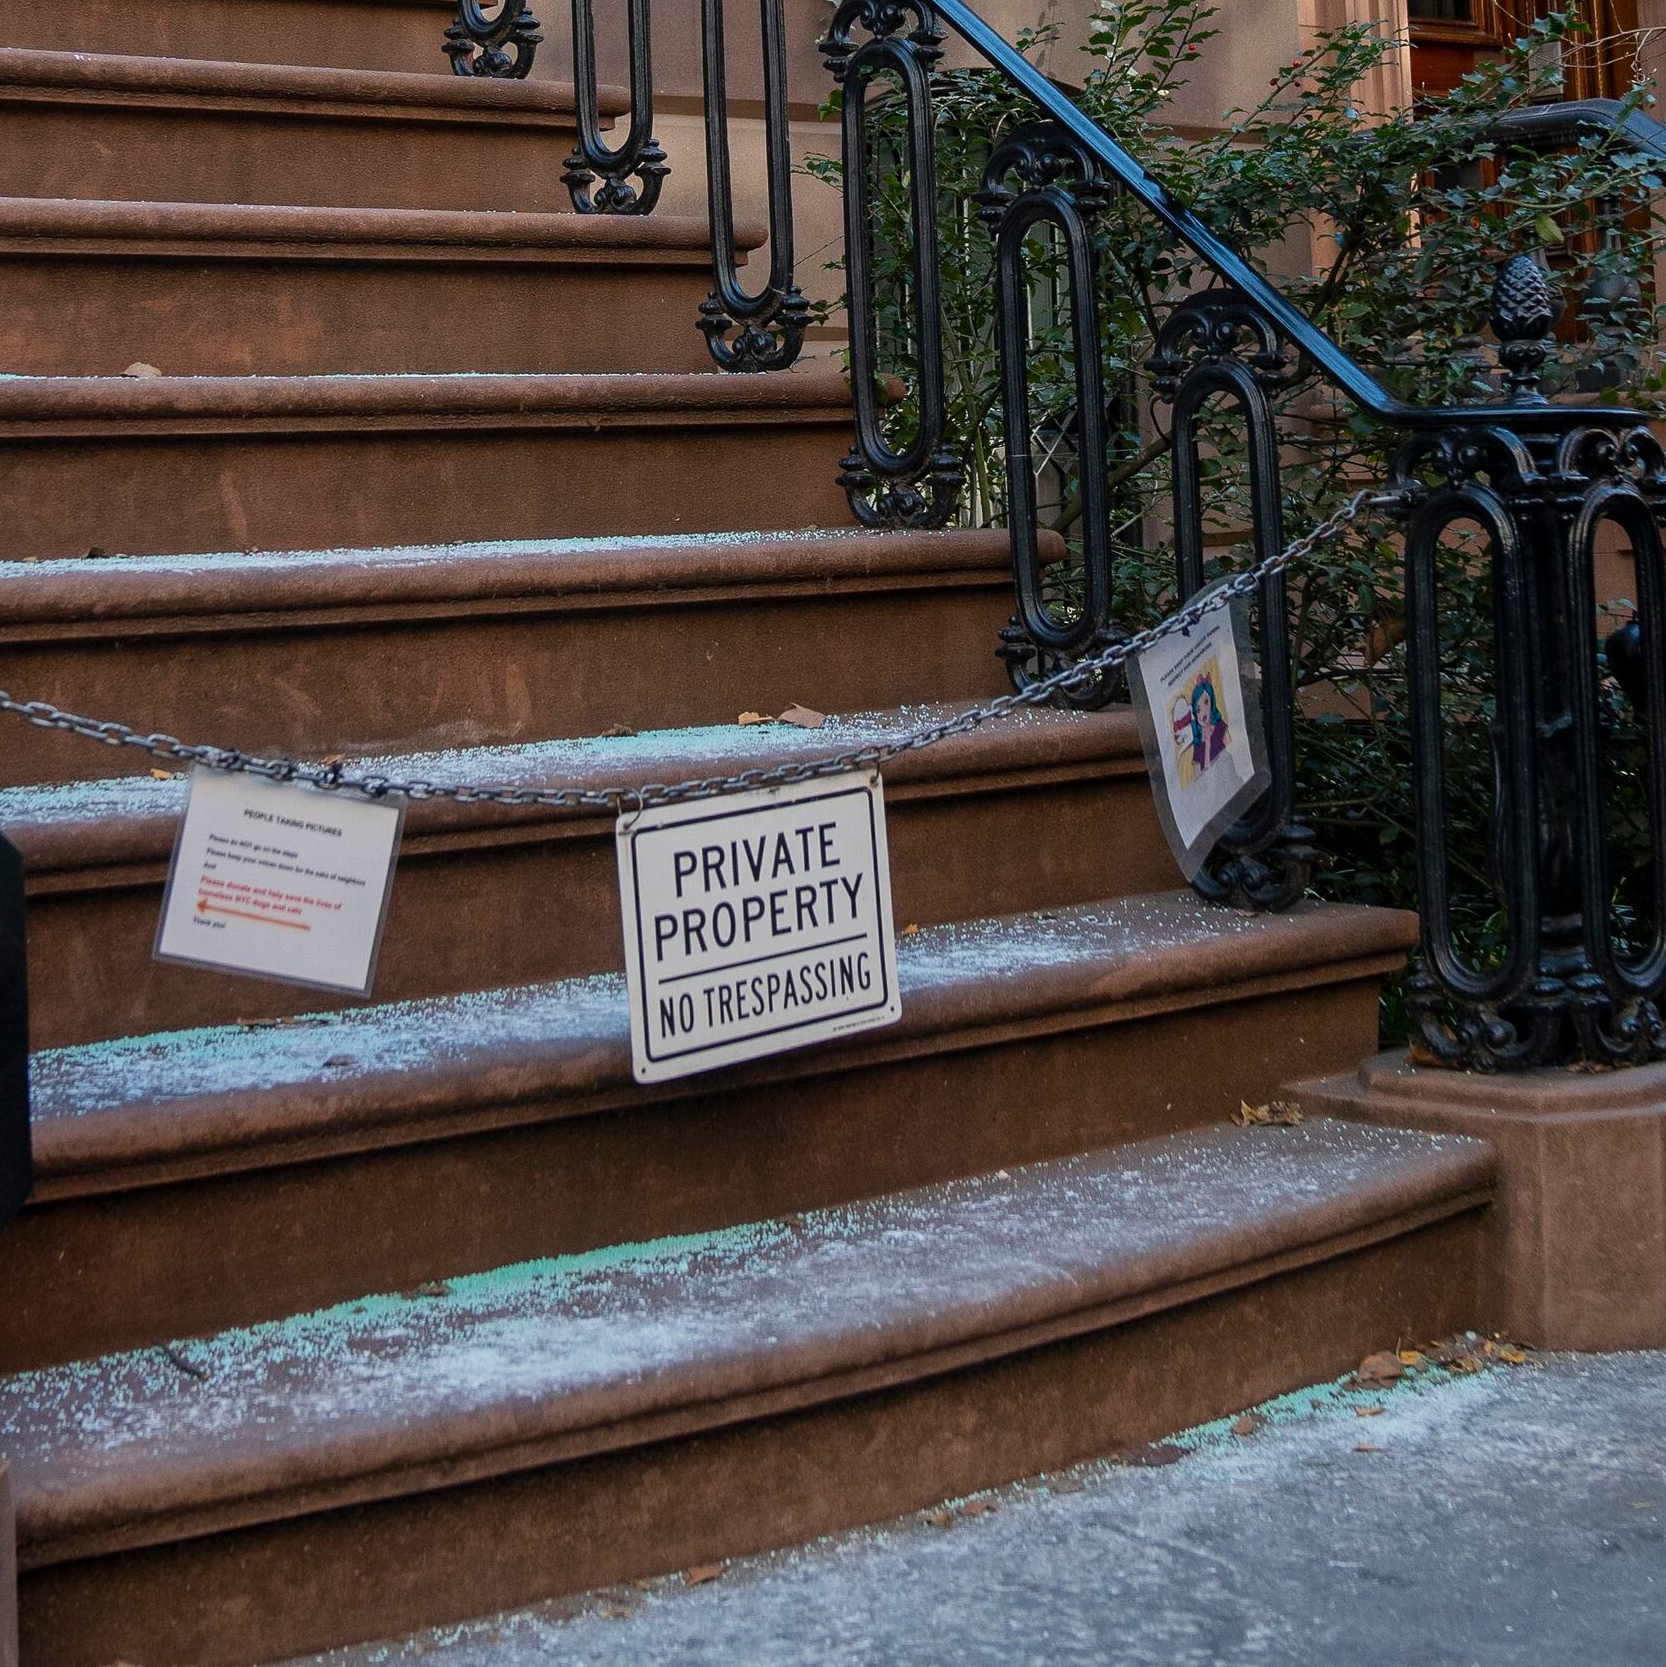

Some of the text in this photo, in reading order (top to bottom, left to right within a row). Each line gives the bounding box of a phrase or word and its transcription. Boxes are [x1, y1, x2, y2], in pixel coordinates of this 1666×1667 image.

[244, 809, 342, 836] PEOPLE TAKING PICTURES
[206, 847, 227, 857] Please
[209, 833, 229, 844] Please
[239, 839, 253, 848] NOT
[673, 821, 841, 898] PRIVATE
[200, 875, 225, 887] Please
[253, 886, 267, 895] and
[654, 872, 864, 962] PROPERTY
[659, 951, 871, 1039] NO TRESPASSING
